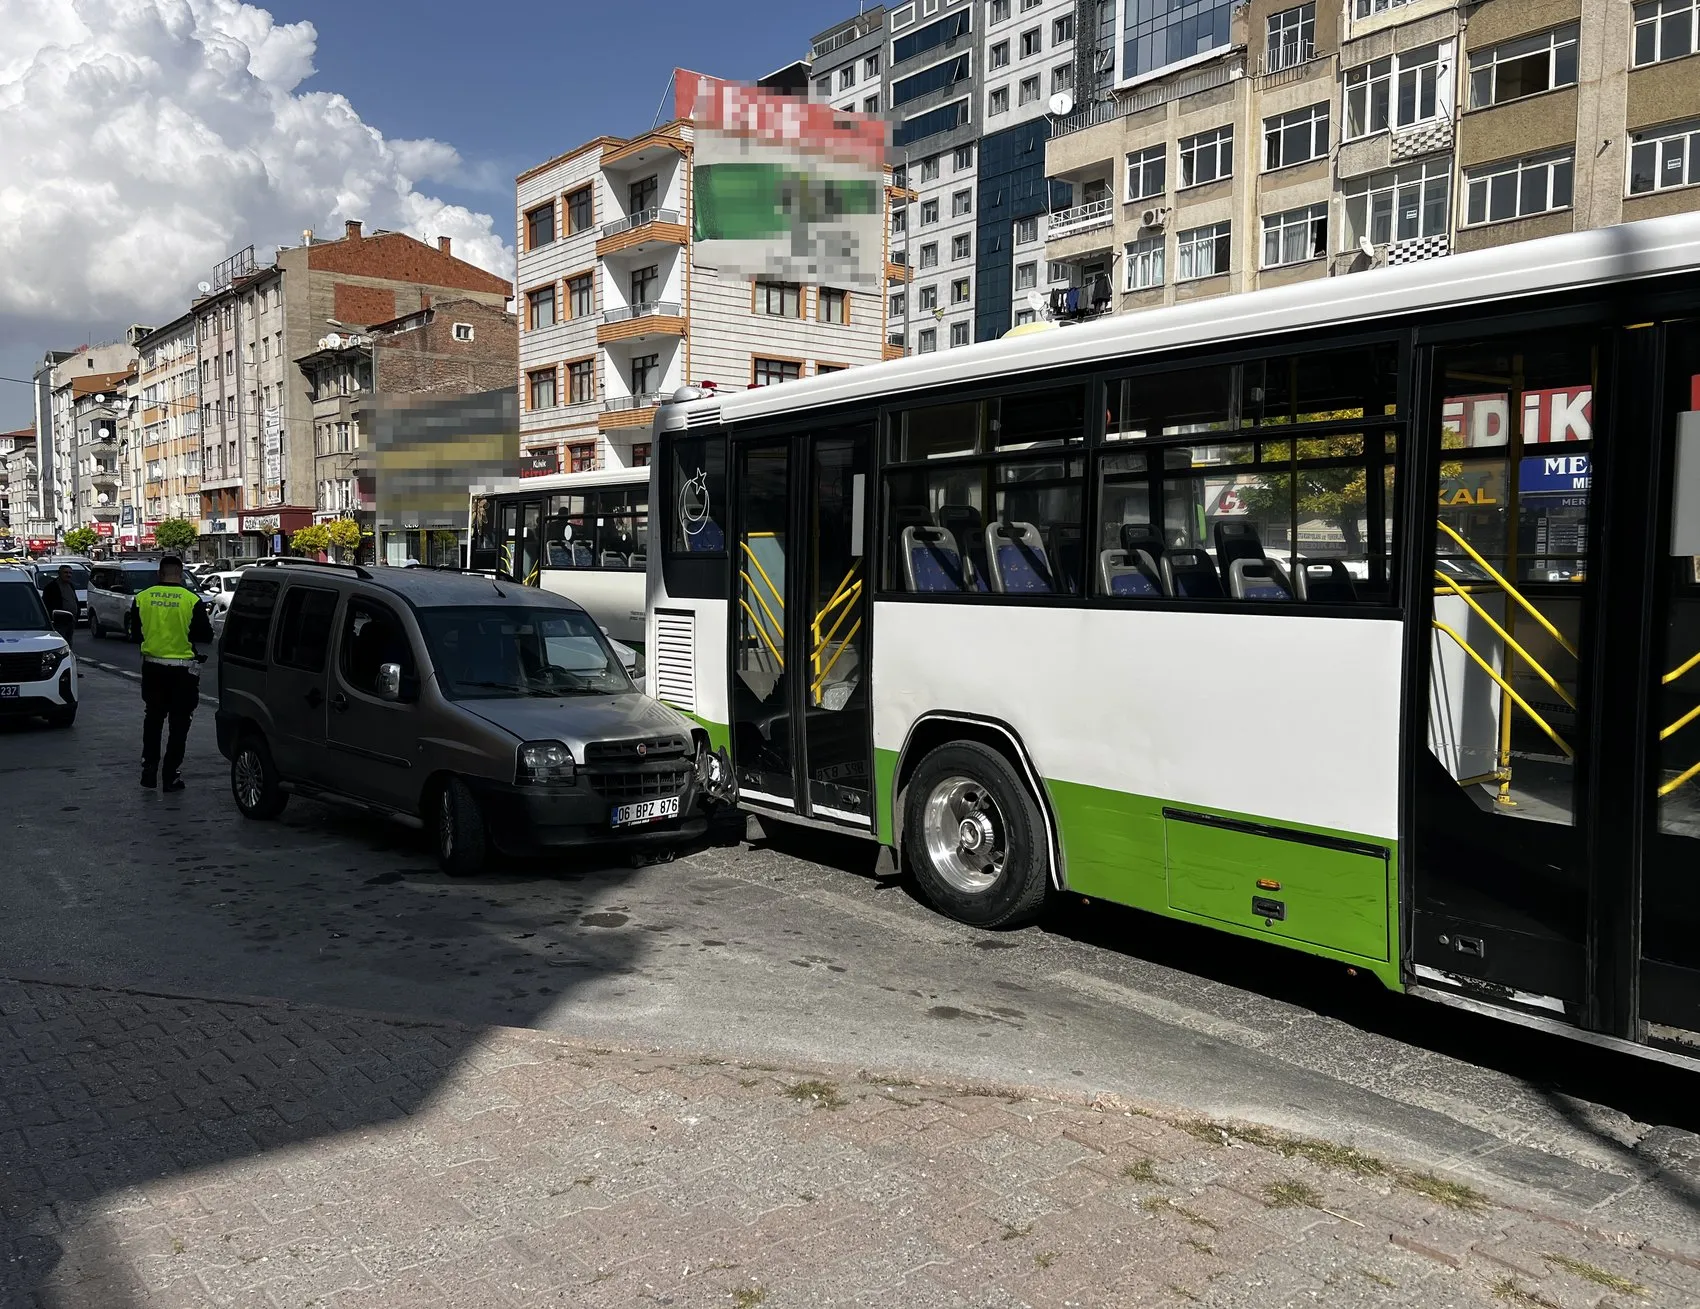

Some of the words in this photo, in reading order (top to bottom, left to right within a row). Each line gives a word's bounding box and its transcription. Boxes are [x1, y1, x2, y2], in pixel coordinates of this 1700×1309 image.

[1544, 455, 1592, 476] ME
[1, 686, 17, 696] 237
[618, 806, 630, 822] 06
[636, 802, 655, 818] BPZ
[660, 798, 678, 815] 876
